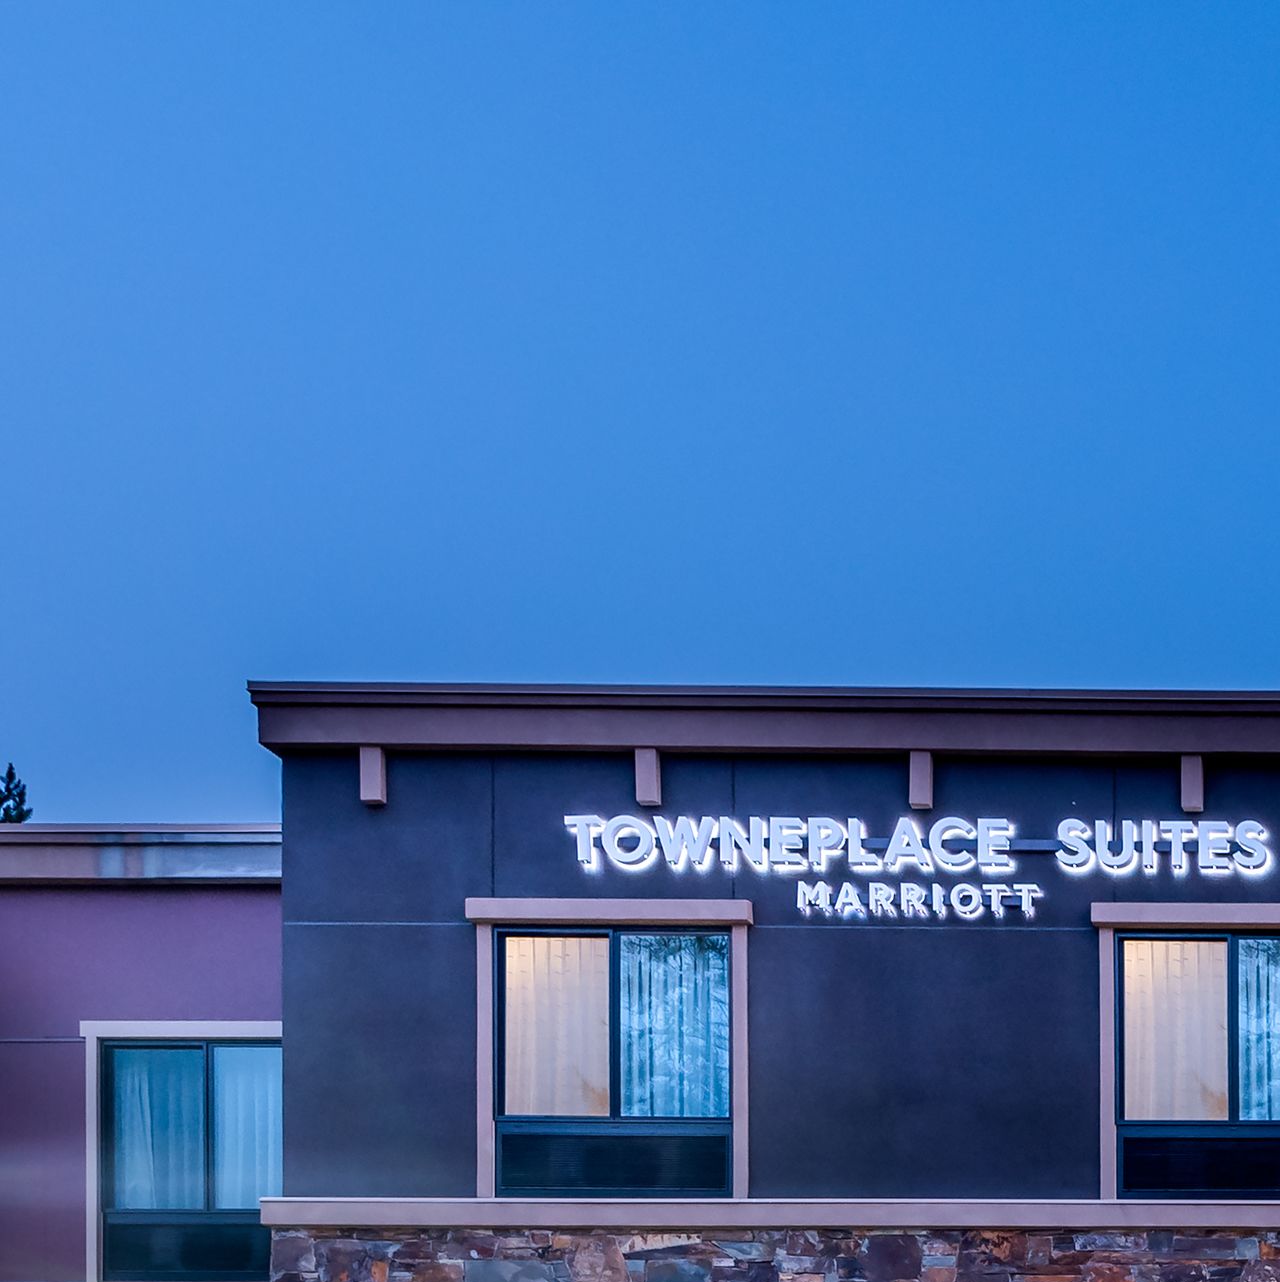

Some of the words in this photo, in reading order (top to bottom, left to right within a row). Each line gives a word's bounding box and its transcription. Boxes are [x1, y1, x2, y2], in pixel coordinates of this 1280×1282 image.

[564, 815, 1014, 869] TOWNEPLACE
[1056, 818, 1269, 870] SUITES
[796, 881, 1041, 917] MARRIOTT
